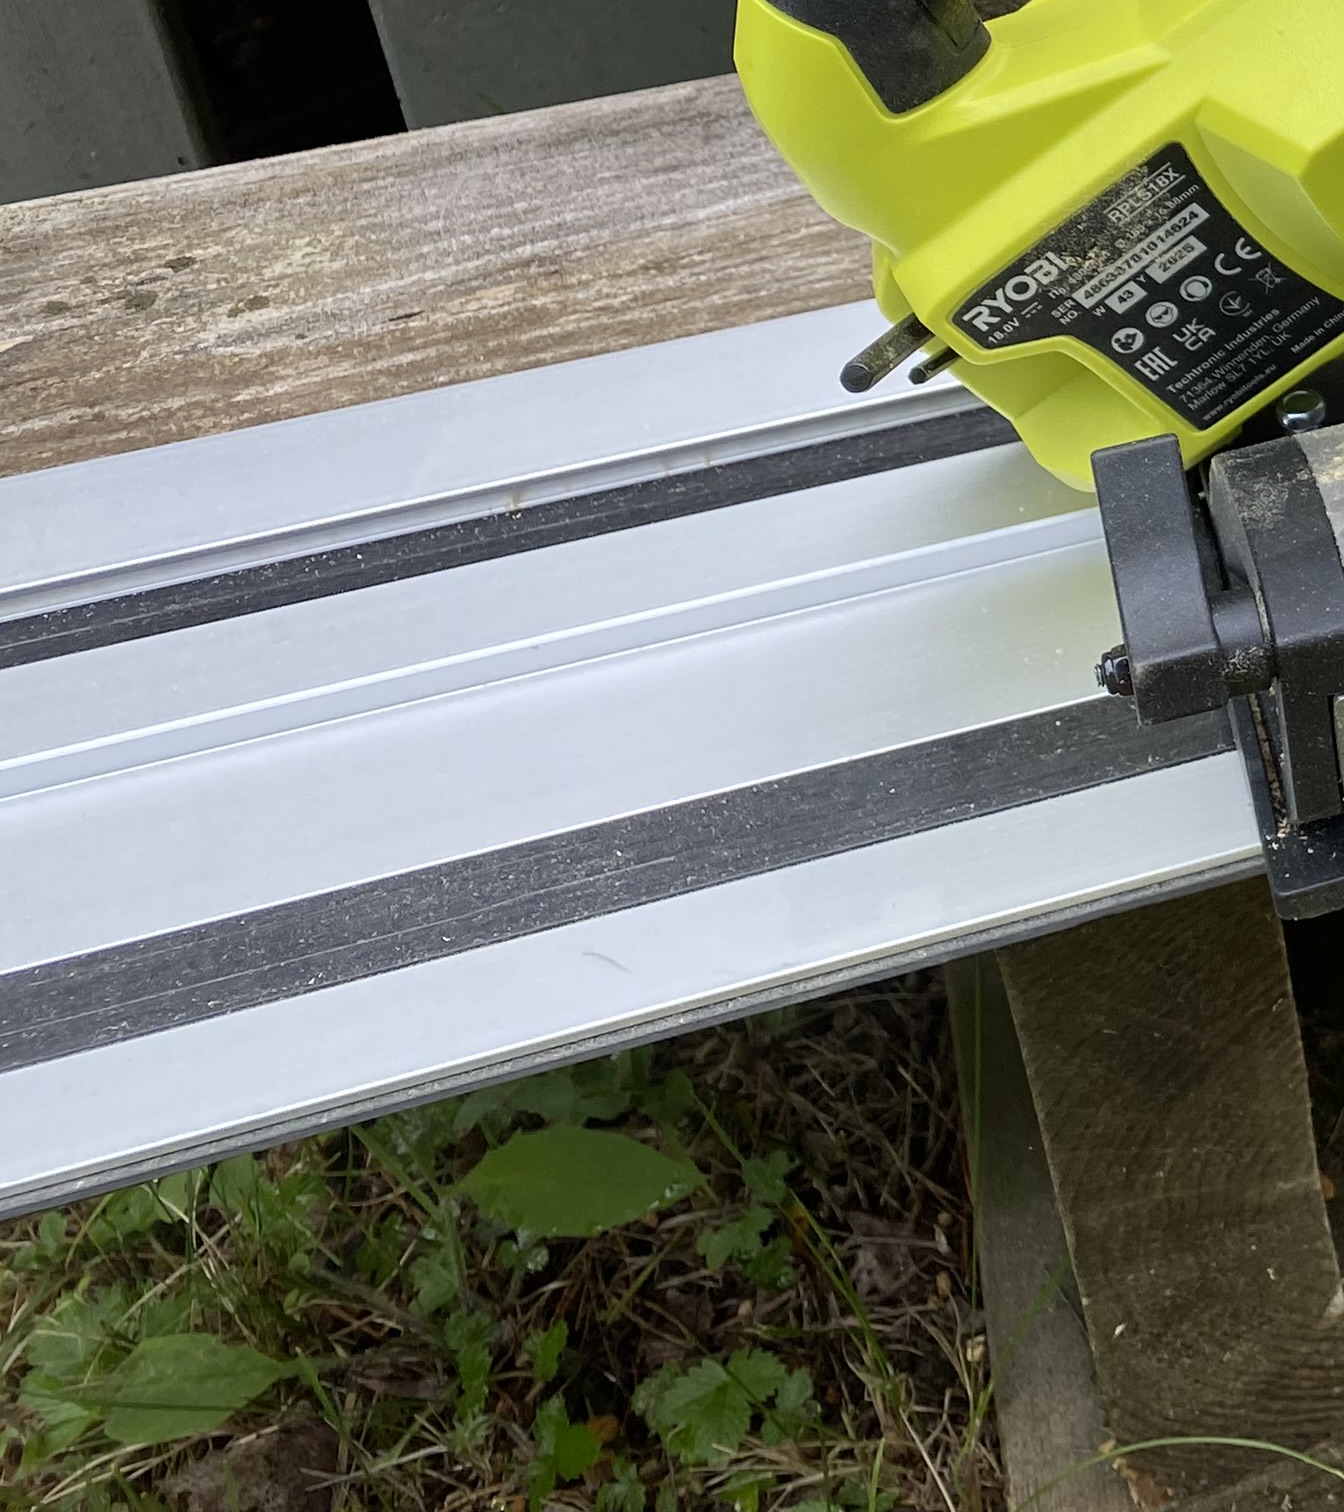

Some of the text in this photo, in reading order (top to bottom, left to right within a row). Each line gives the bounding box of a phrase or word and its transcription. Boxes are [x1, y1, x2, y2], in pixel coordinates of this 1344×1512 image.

[1108, 167, 1180, 223] RPLS18X
[962, 251, 1071, 331] RYOBI
[1051, 298, 1076, 319] SER
[1092, 305, 1107, 317] W
[1116, 288, 1135, 304] 43
[1138, 273, 1148, 284] Y
[988, 317, 1020, 344] 18.0V
[1172, 317, 1205, 343] UK
[1272, 296, 1321, 334] Germany
[1167, 308, 1280, 393] Techtronic Industries
[1184, 327, 1216, 351] CA
[1290, 335, 1314, 354] Made
[1314, 327, 1325, 338] in
[1187, 380, 1226, 411] Marlow
[1227, 363, 1248, 383] SL7
[1270, 330, 1293, 347] UK
[1203, 364, 1277, 422] www.ryobitools.eu
